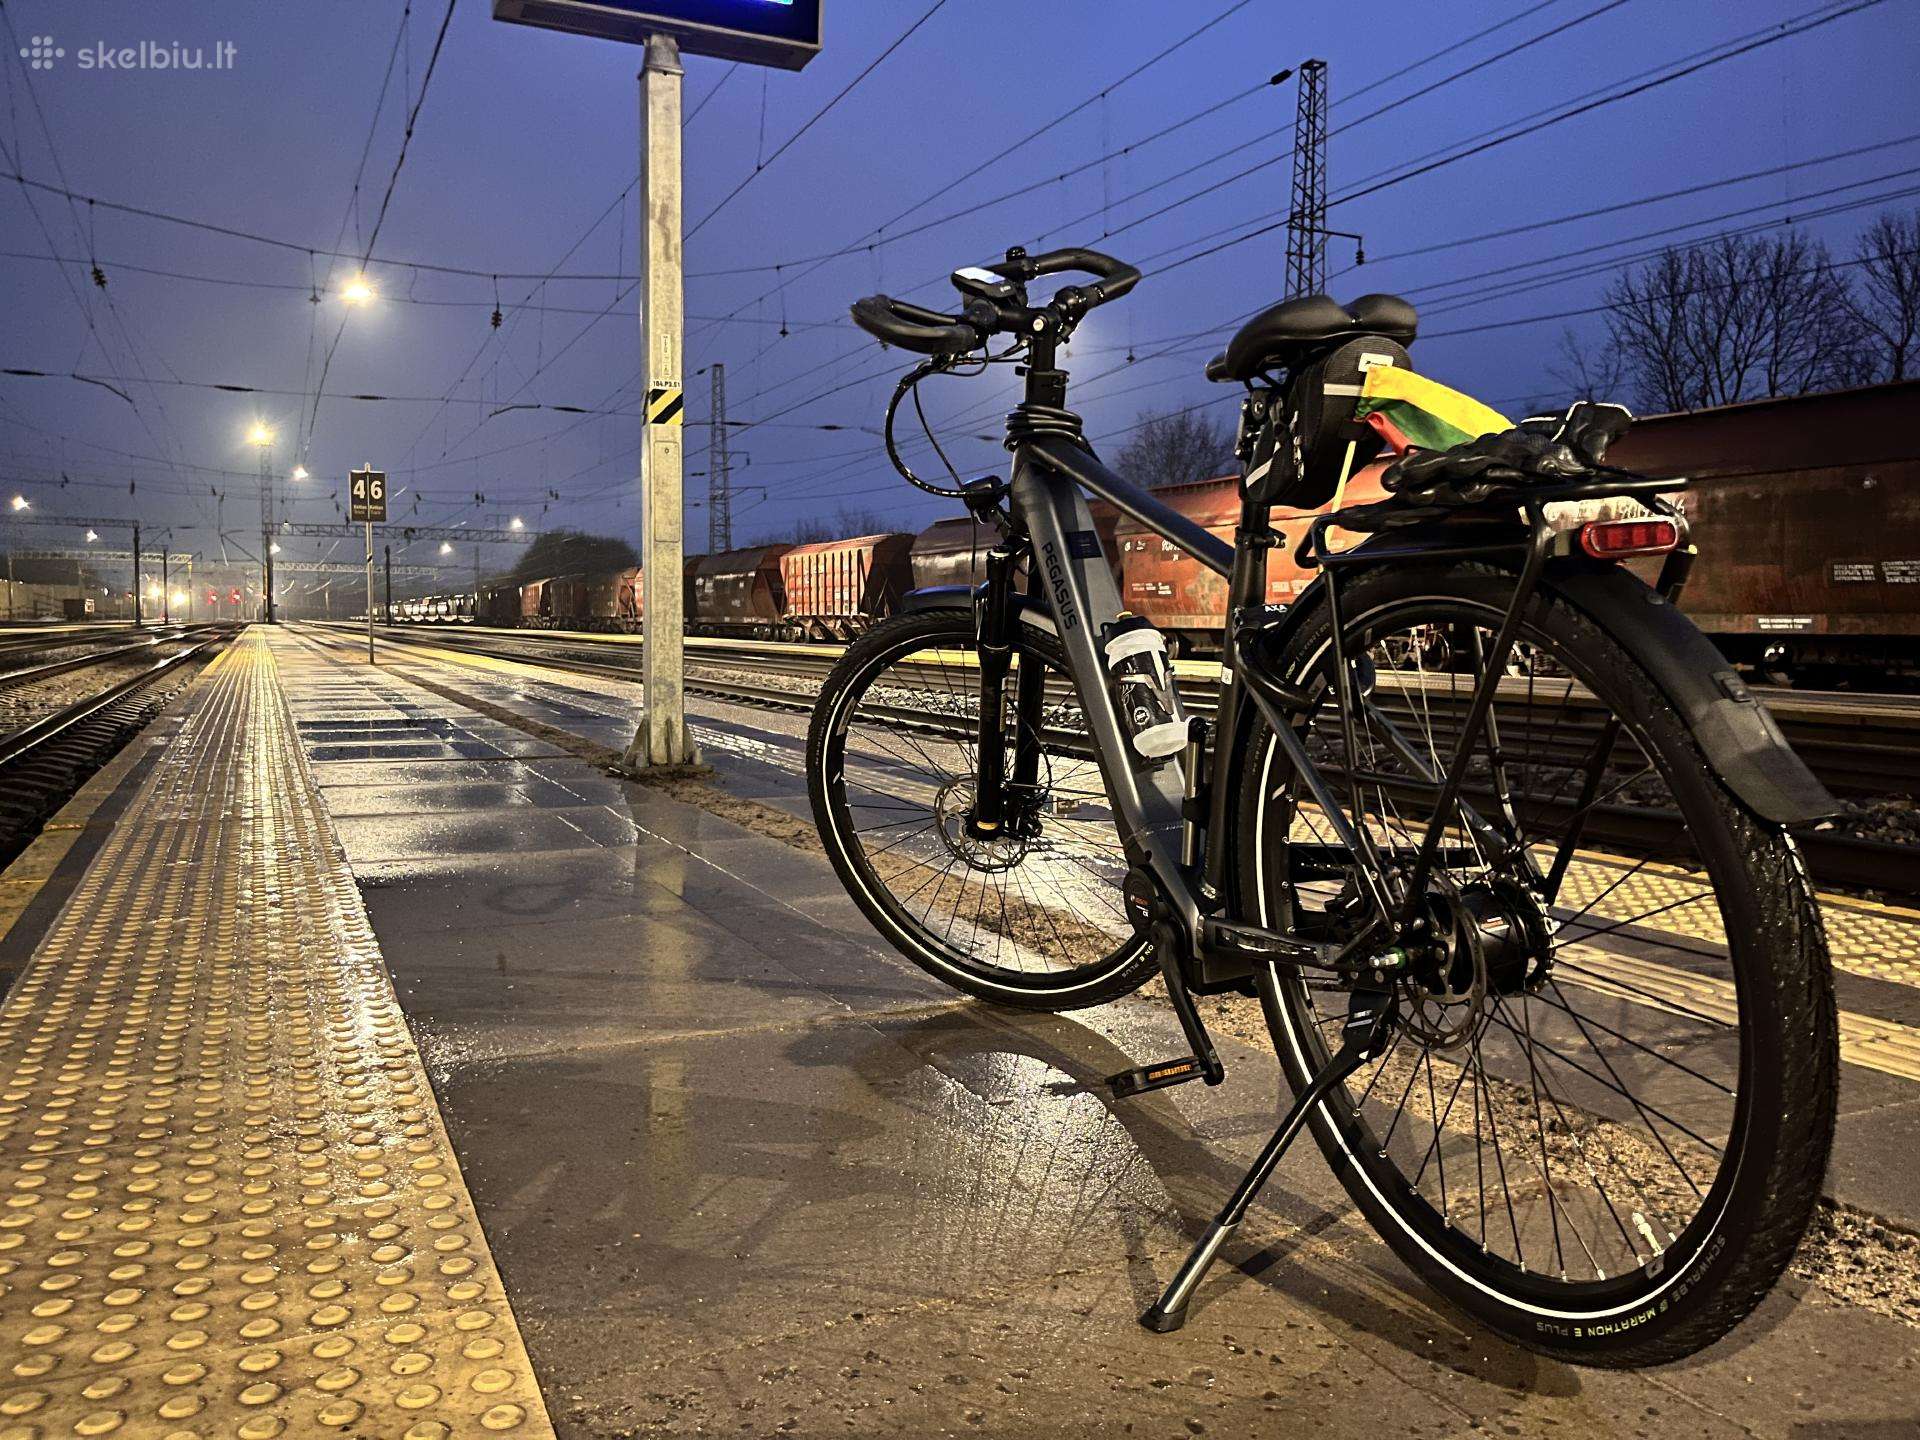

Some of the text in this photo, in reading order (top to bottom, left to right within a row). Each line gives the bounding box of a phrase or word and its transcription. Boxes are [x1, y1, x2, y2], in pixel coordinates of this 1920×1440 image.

[353, 480, 366, 499] 4
[370, 480, 383, 500] 6
[1042, 542, 1077, 630] PEGASUS
[1536, 1234, 1726, 1337] SCHWALBE MARATHON E PLUS
